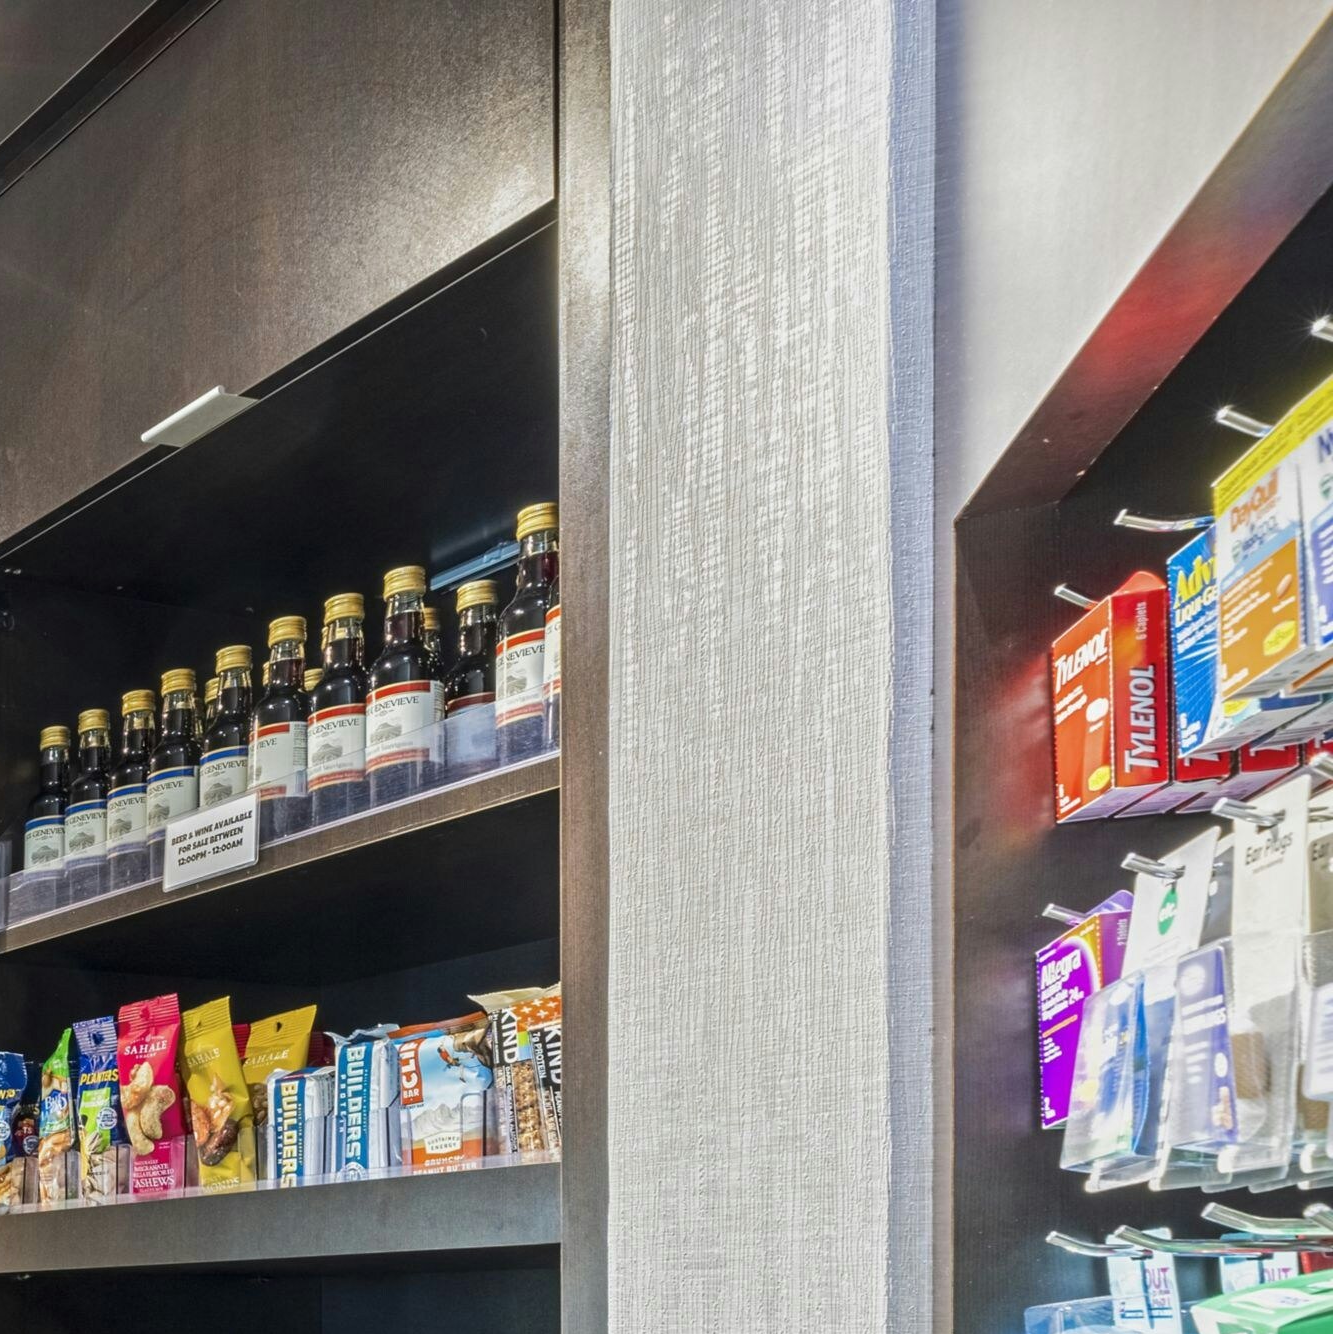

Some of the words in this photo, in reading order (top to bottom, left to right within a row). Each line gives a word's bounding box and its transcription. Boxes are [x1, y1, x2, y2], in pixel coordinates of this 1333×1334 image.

[1055, 627, 1109, 694] TYLENOL
[1124, 665, 1160, 773] TYLENOL
[171, 833, 188, 846] BEER
[194, 823, 213, 838] WINE
[213, 809, 253, 832] AVAILABLE
[178, 843, 192, 855] FOR
[192, 838, 210, 851] SALE
[209, 825, 244, 845] BETWEEN
[123, 1040, 169, 1056] SAHALE
[500, 1008, 519, 1064] KIND
[79, 1068, 120, 1086] PLANTERS
[400, 1040, 419, 1089] CLIF
[402, 1087, 420, 1099] BAR
[430, 1142, 457, 1151] ENERGY
